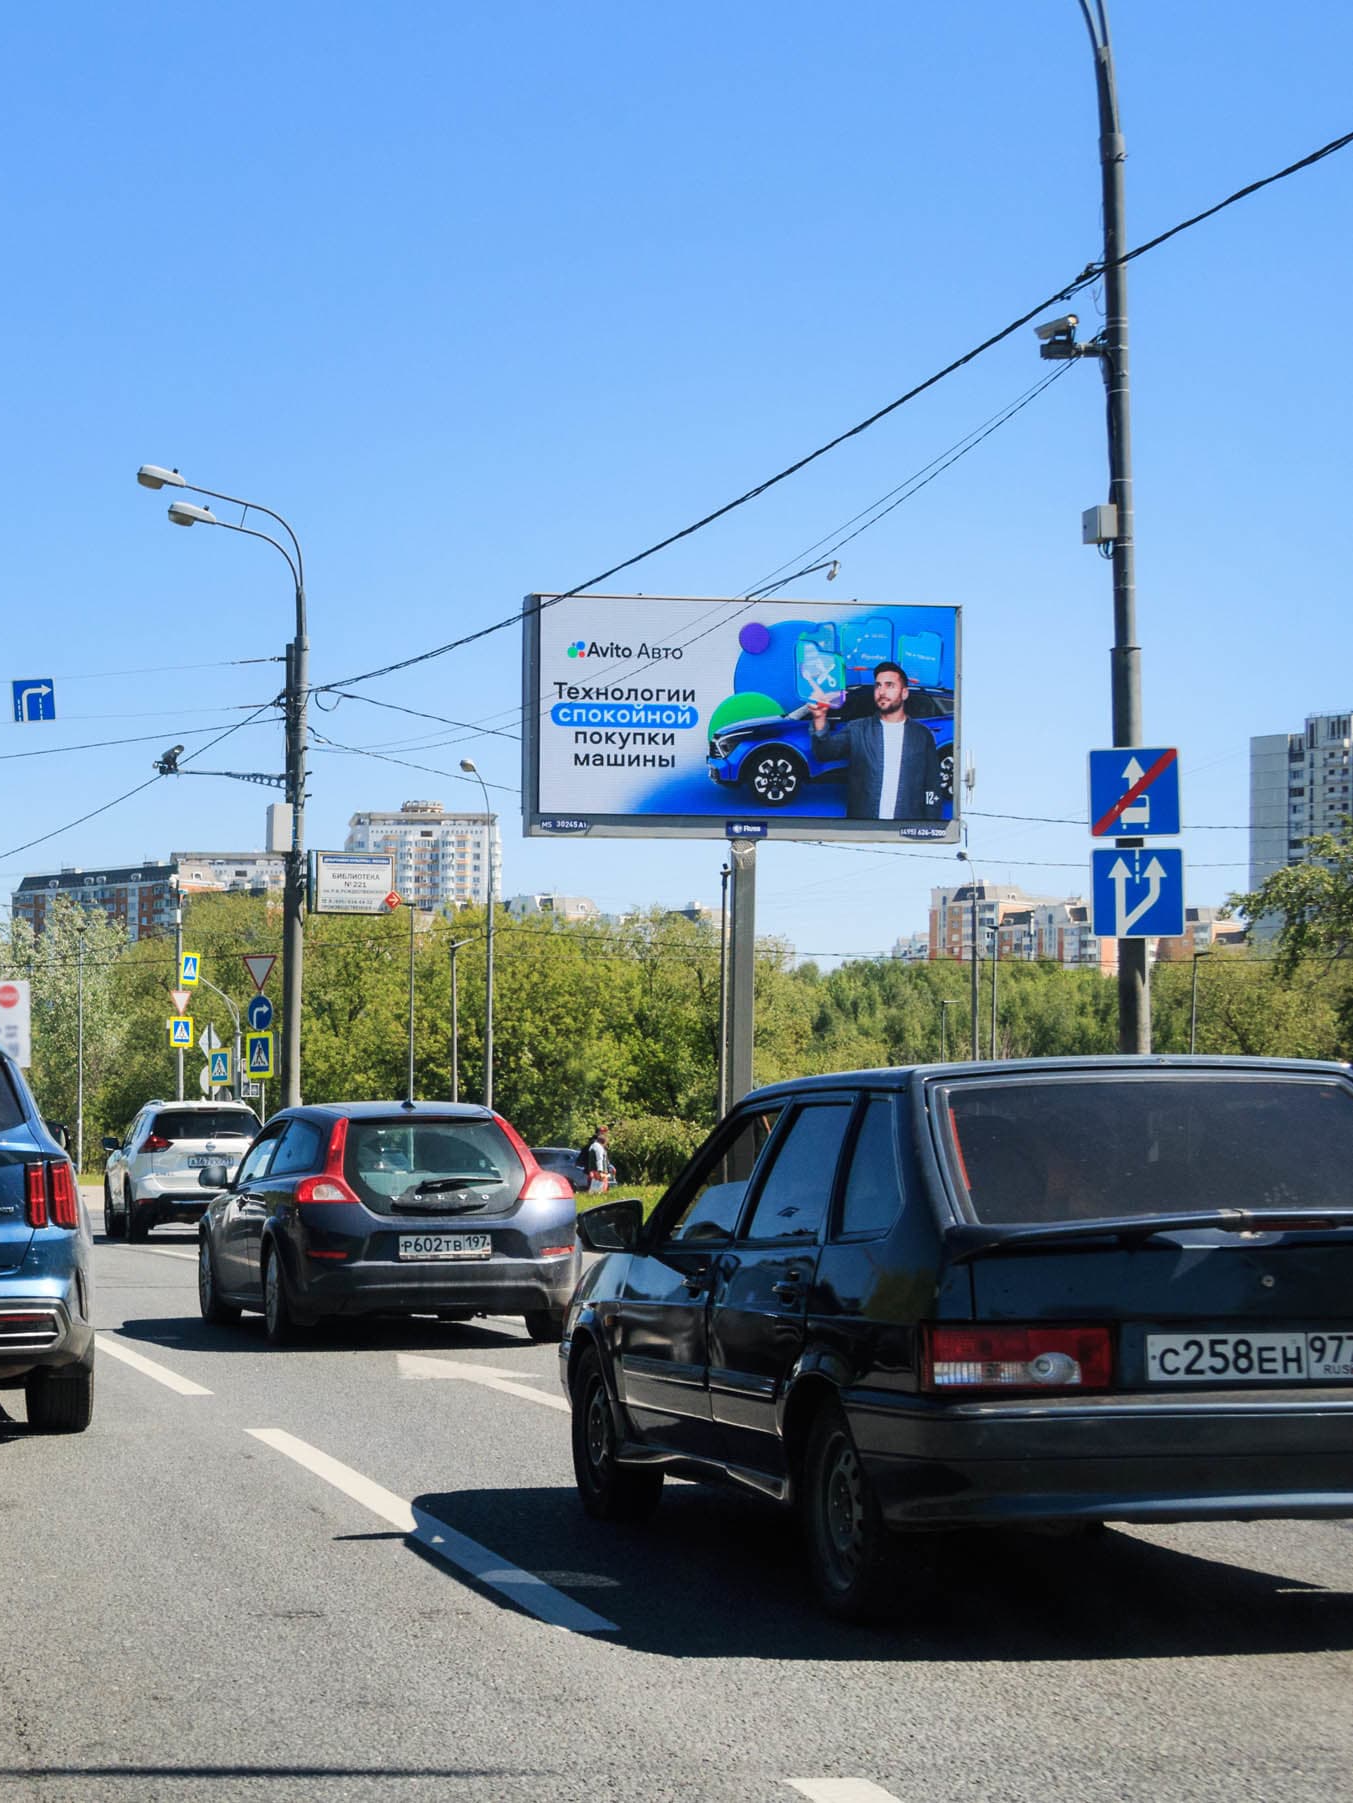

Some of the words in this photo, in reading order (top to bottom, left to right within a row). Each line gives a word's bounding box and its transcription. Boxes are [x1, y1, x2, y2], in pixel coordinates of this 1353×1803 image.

[587, 642, 632, 658] Avito
[637, 643, 683, 660] Авто
[553, 682, 696, 702] Технологии
[558, 704, 691, 724] спокойной
[574, 731, 675, 750] покупки
[574, 753, 675, 768] машины
[925, 791, 940, 805] 12+
[332, 872, 380, 880] БИБЛИОТЕКА
[465, 1235, 487, 1248] 197
